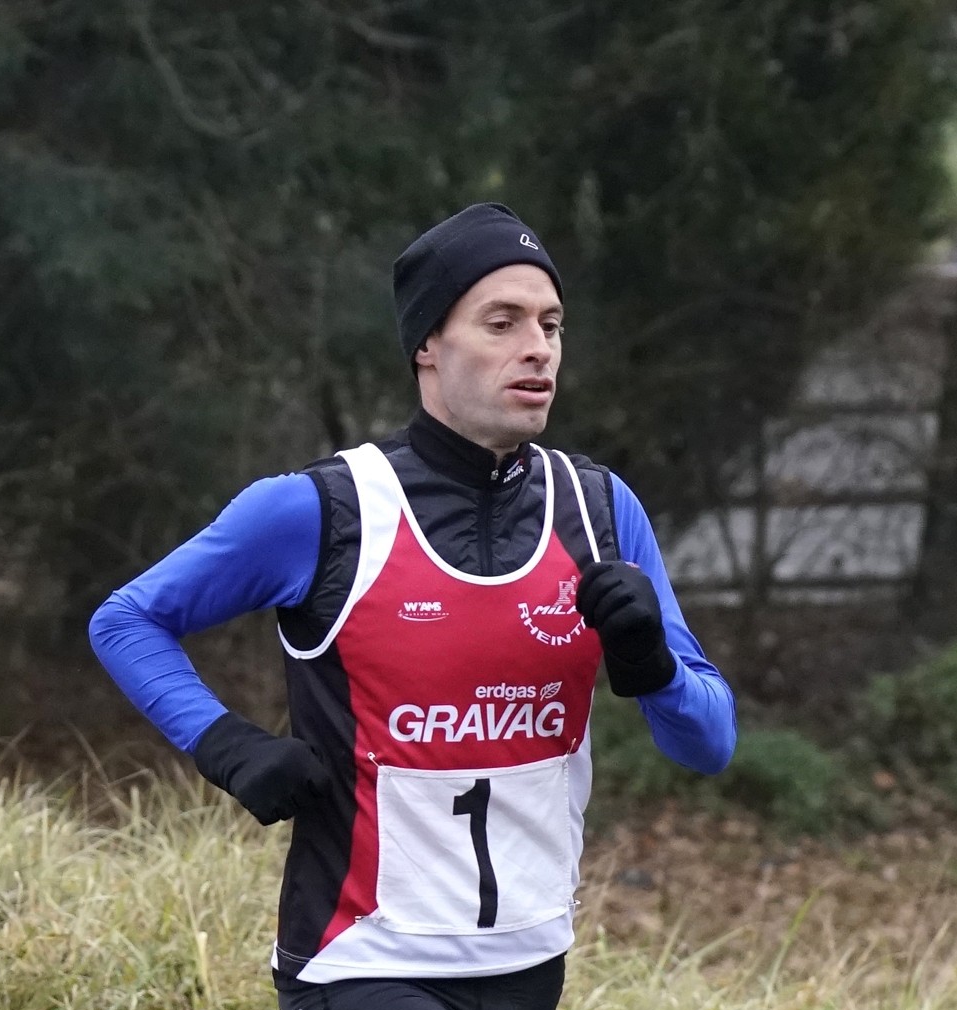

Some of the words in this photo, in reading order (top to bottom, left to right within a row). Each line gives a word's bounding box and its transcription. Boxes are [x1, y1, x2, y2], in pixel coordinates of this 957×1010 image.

[475, 683, 537, 701] erdgas
[388, 701, 566, 743] GRAVAG
[453, 778, 498, 928] 1
